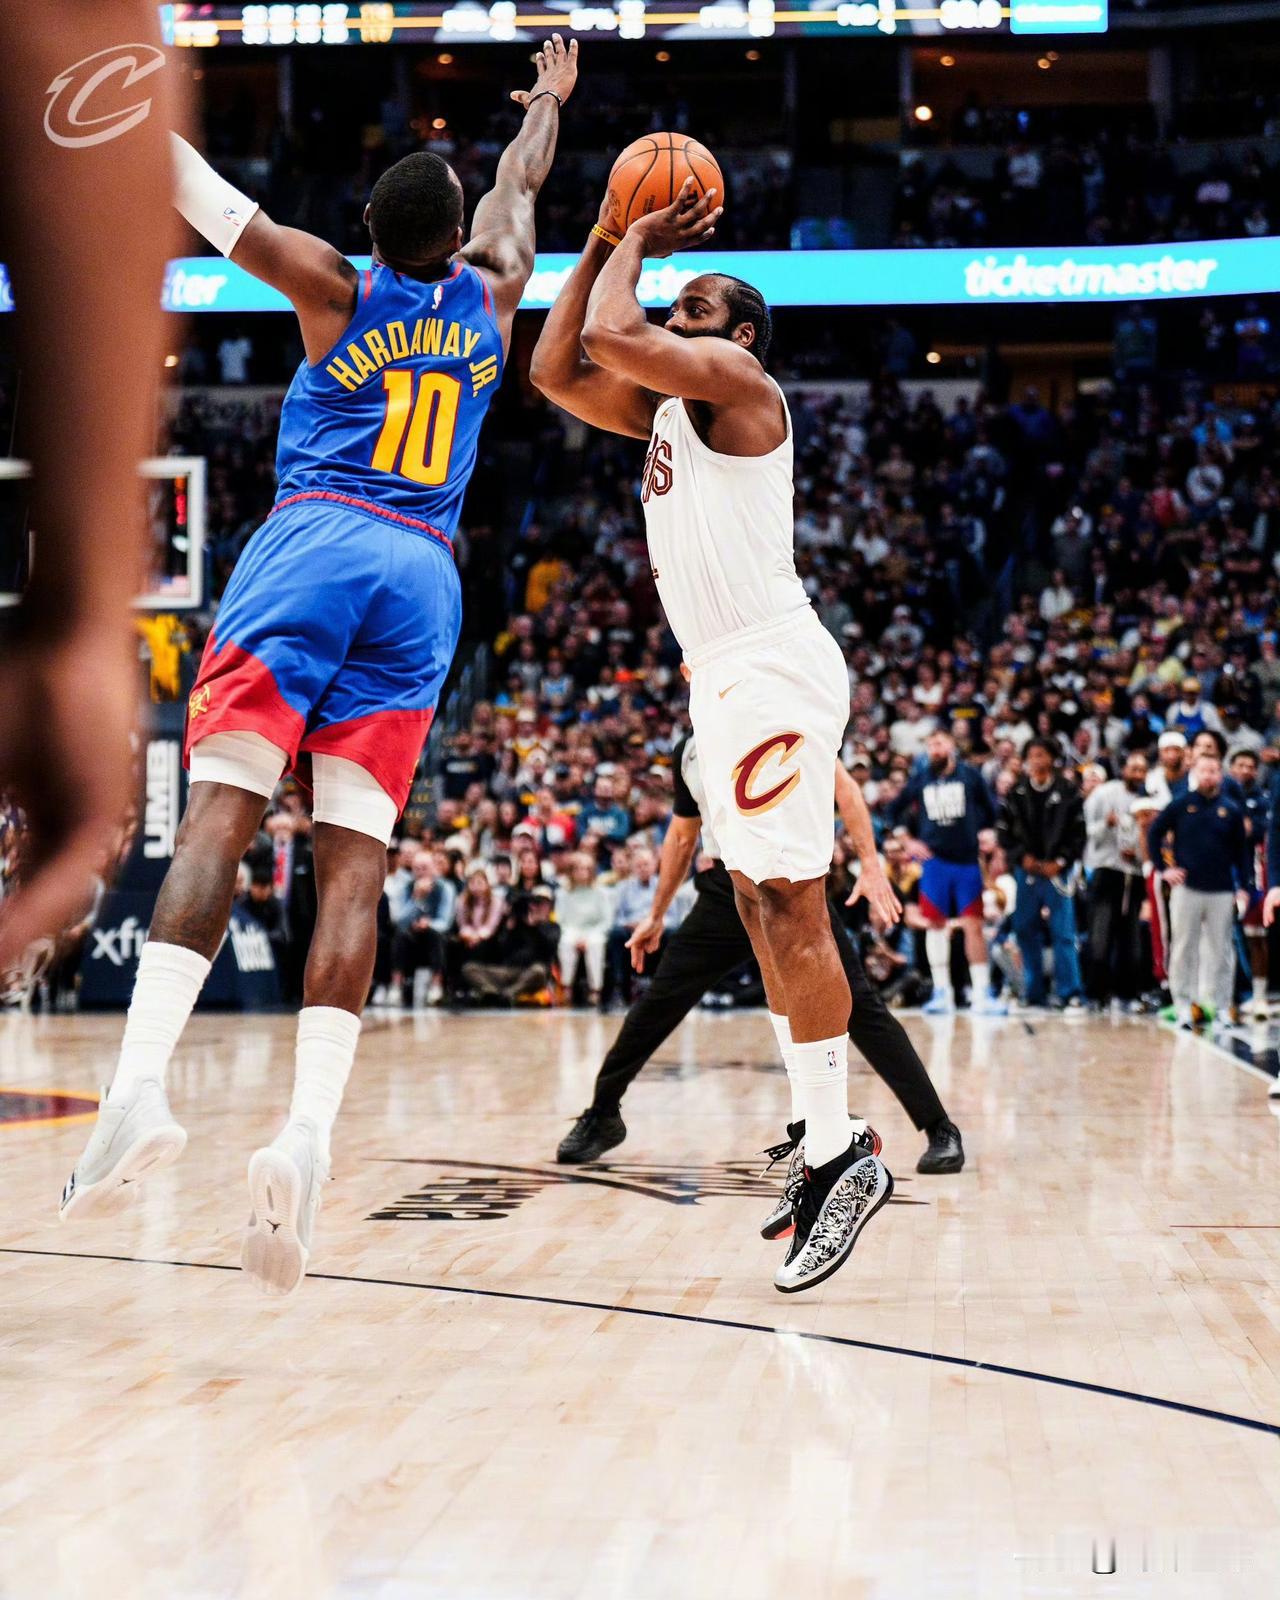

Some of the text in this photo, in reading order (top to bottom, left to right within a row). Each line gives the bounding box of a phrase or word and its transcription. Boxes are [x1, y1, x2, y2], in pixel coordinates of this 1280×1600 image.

[964, 254, 1219, 297] ticketmaster
[325, 317, 499, 398] HARDAWAY JR.
[370, 368, 462, 487] 10
[143, 739, 172, 859] UMB
